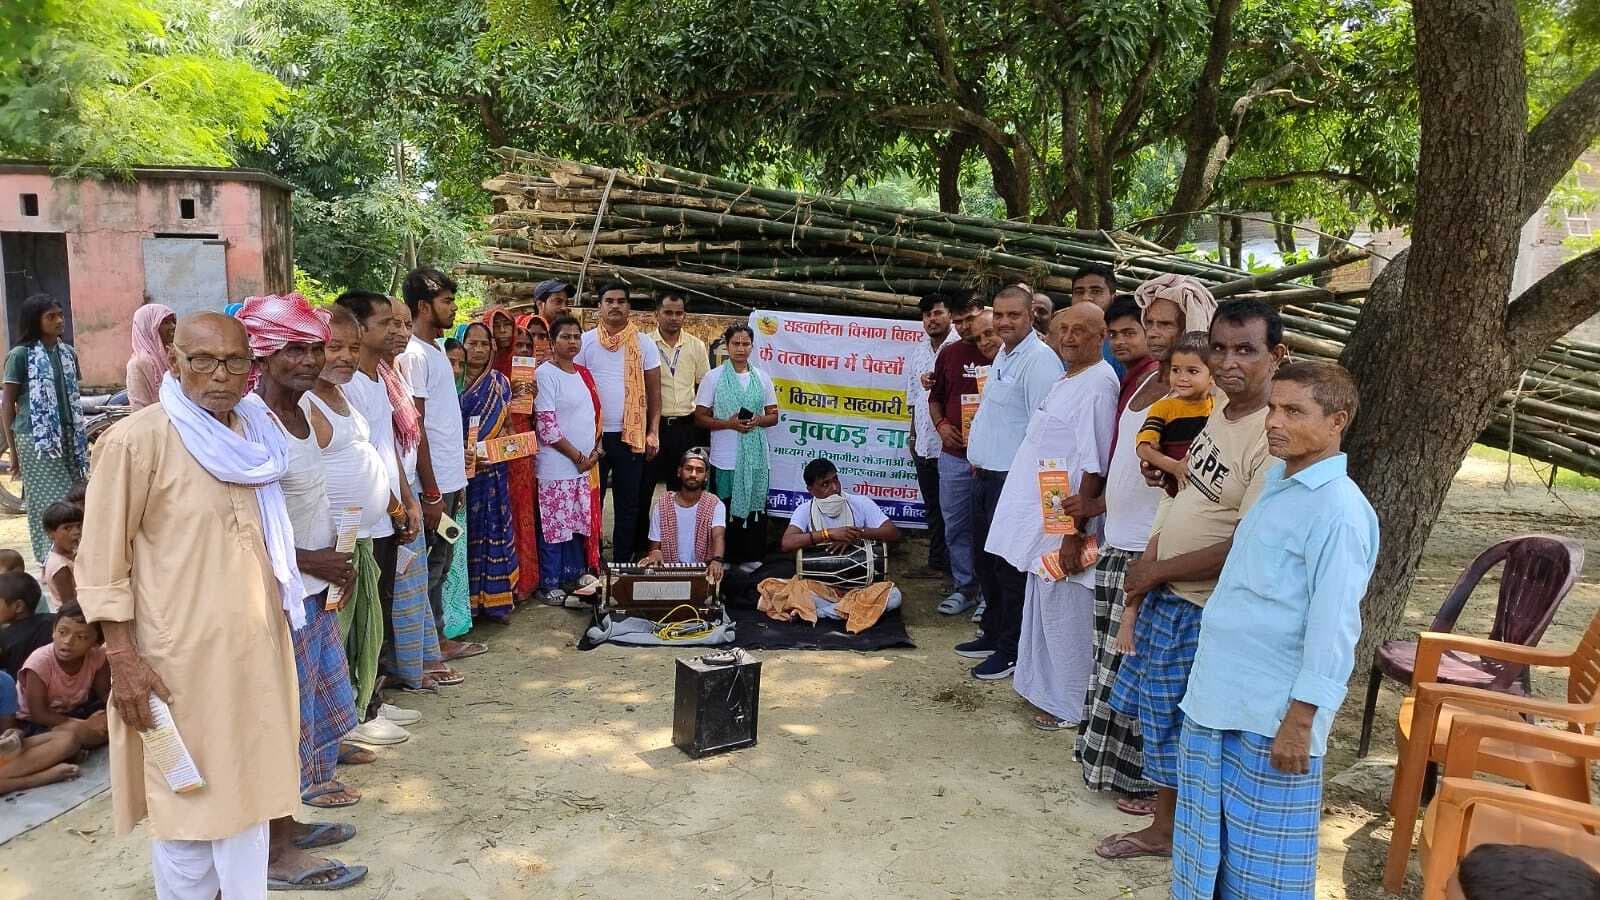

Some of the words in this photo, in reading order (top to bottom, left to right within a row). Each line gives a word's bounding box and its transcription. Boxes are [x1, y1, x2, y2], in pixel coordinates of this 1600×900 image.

[784, 319, 843, 337] सहकारिता
[848, 322, 887, 340] विभाग
[891, 325, 926, 343] बिहार
[760, 344, 774, 361] के
[777, 349, 840, 369] तत्वाधान
[844, 352, 858, 372] में
[789, 386, 839, 408] किसान
[842, 395, 903, 416] सहकारी
[876, 427, 910, 449] ना
[862, 454, 905, 467] योजनाओं
[852, 480, 918, 500] गोपालगंज
